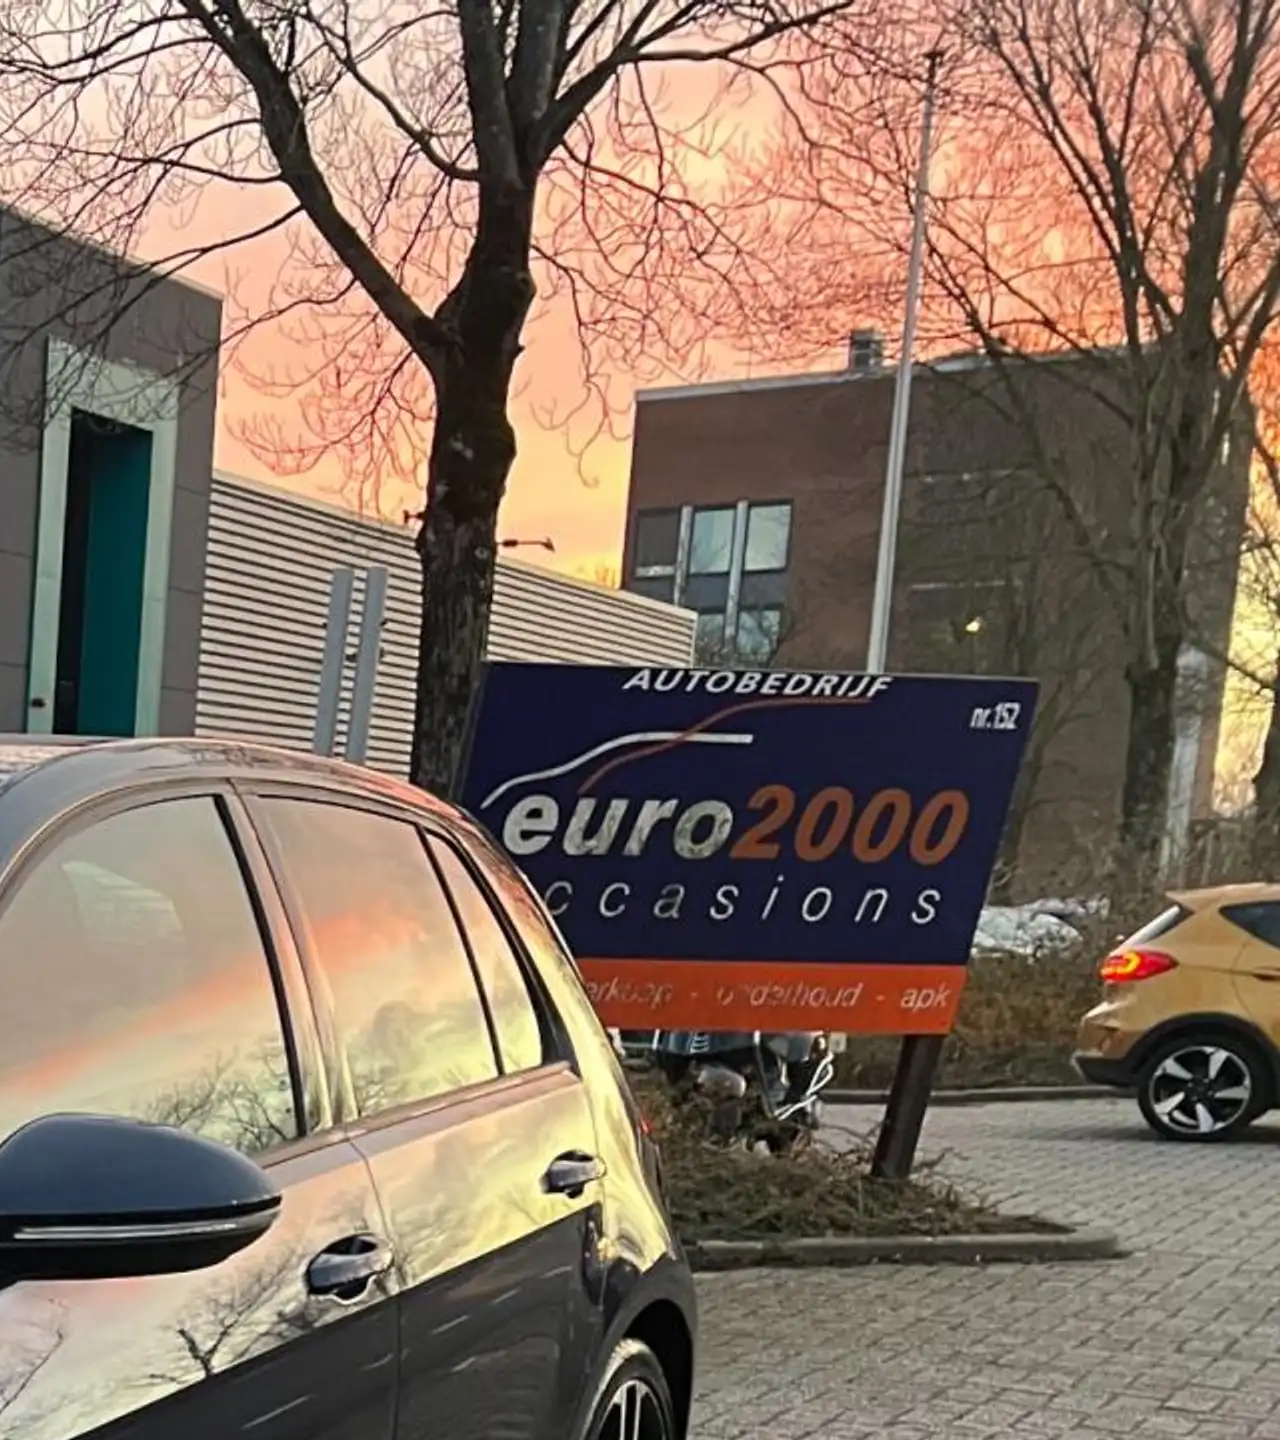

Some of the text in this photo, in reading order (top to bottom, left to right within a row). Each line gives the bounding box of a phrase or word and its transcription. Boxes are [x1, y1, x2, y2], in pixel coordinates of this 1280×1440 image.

[622, 668, 895, 698] AUTOBEDRIJF
[503, 784, 970, 865] euro2000
[544, 874, 942, 924] ccasions
[900, 982, 953, 1013] apk
